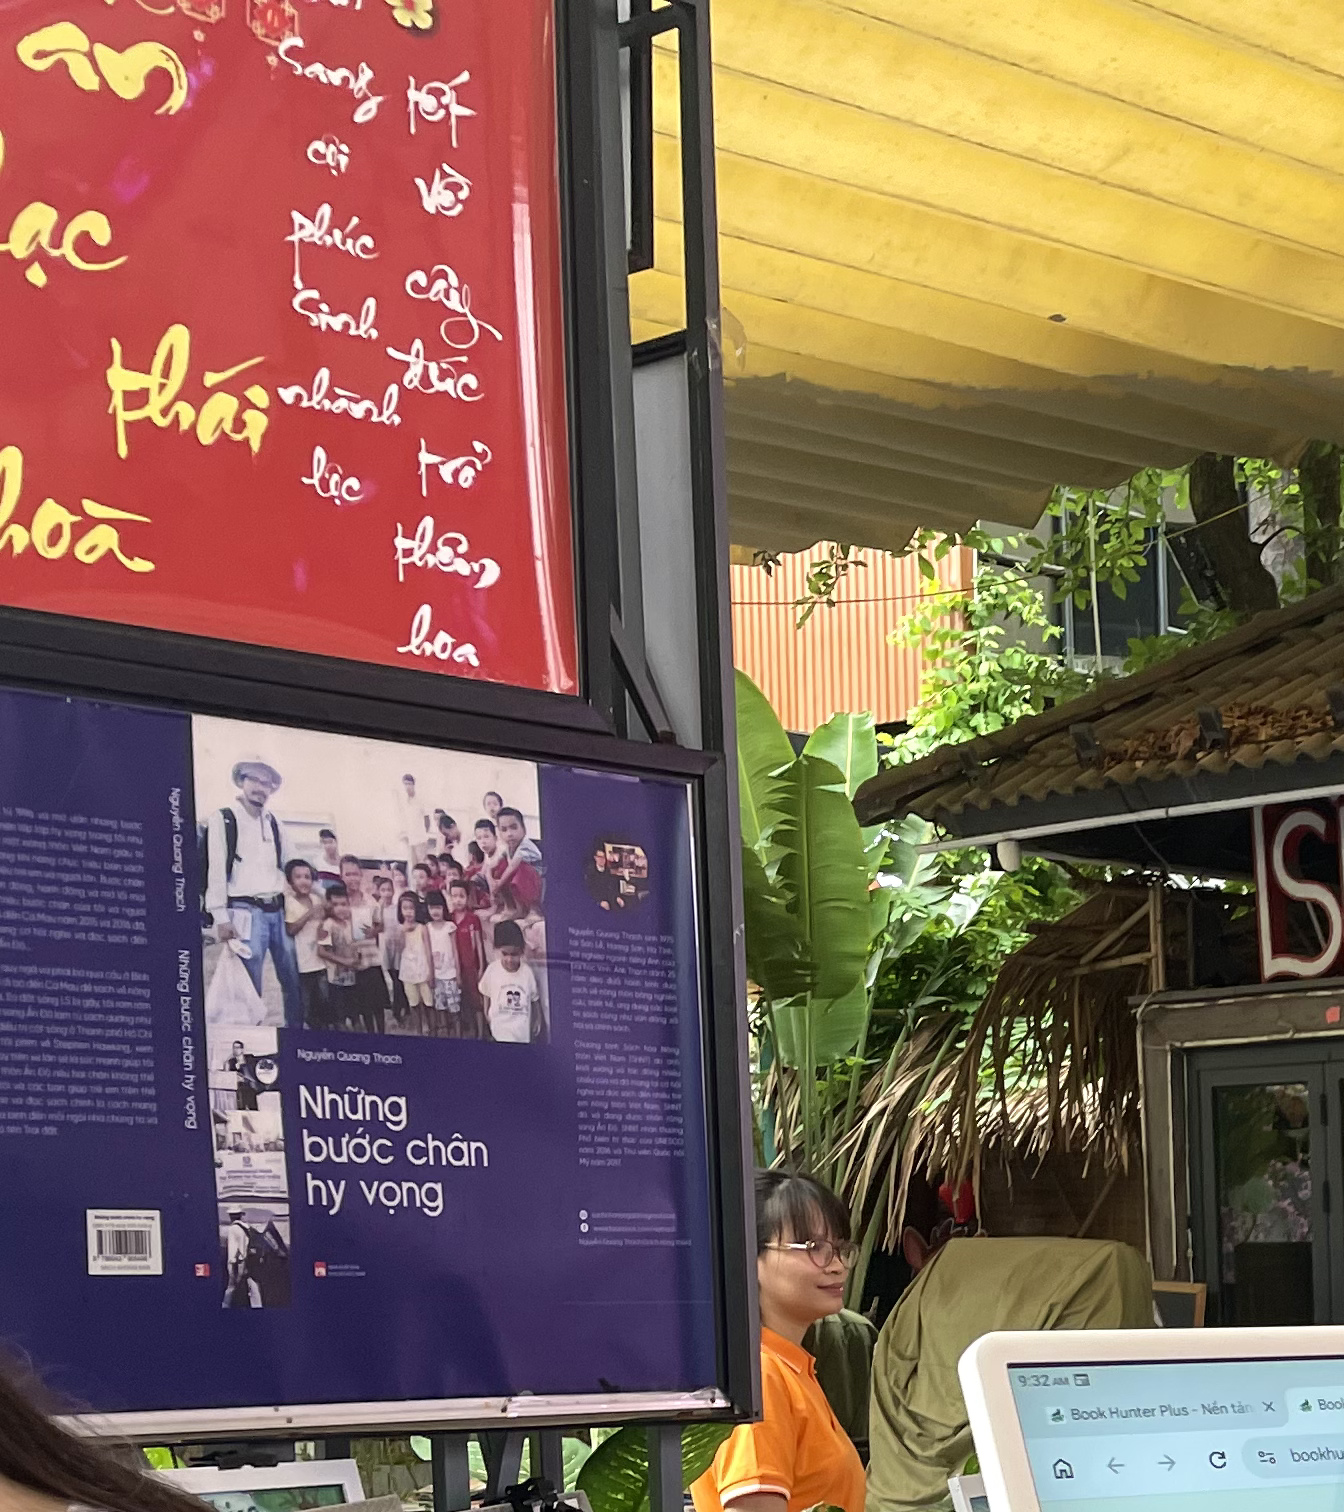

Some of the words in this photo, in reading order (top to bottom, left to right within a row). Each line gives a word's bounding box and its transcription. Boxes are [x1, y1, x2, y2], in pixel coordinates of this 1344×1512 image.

[397, 604, 479, 666] hoa
[299, 1085, 407, 1131] Những
[302, 1127, 394, 1164] bước
[406, 1133, 488, 1167] chân
[306, 1172, 345, 1215] hy
[360, 1180, 443, 1217] vọng
[1018, 1375, 1050, 1387] 9:32
[1071, 1408, 1106, 1421] Book
[1109, 1406, 1155, 1419] Hunter
[1160, 1404, 1188, 1417] Plus
